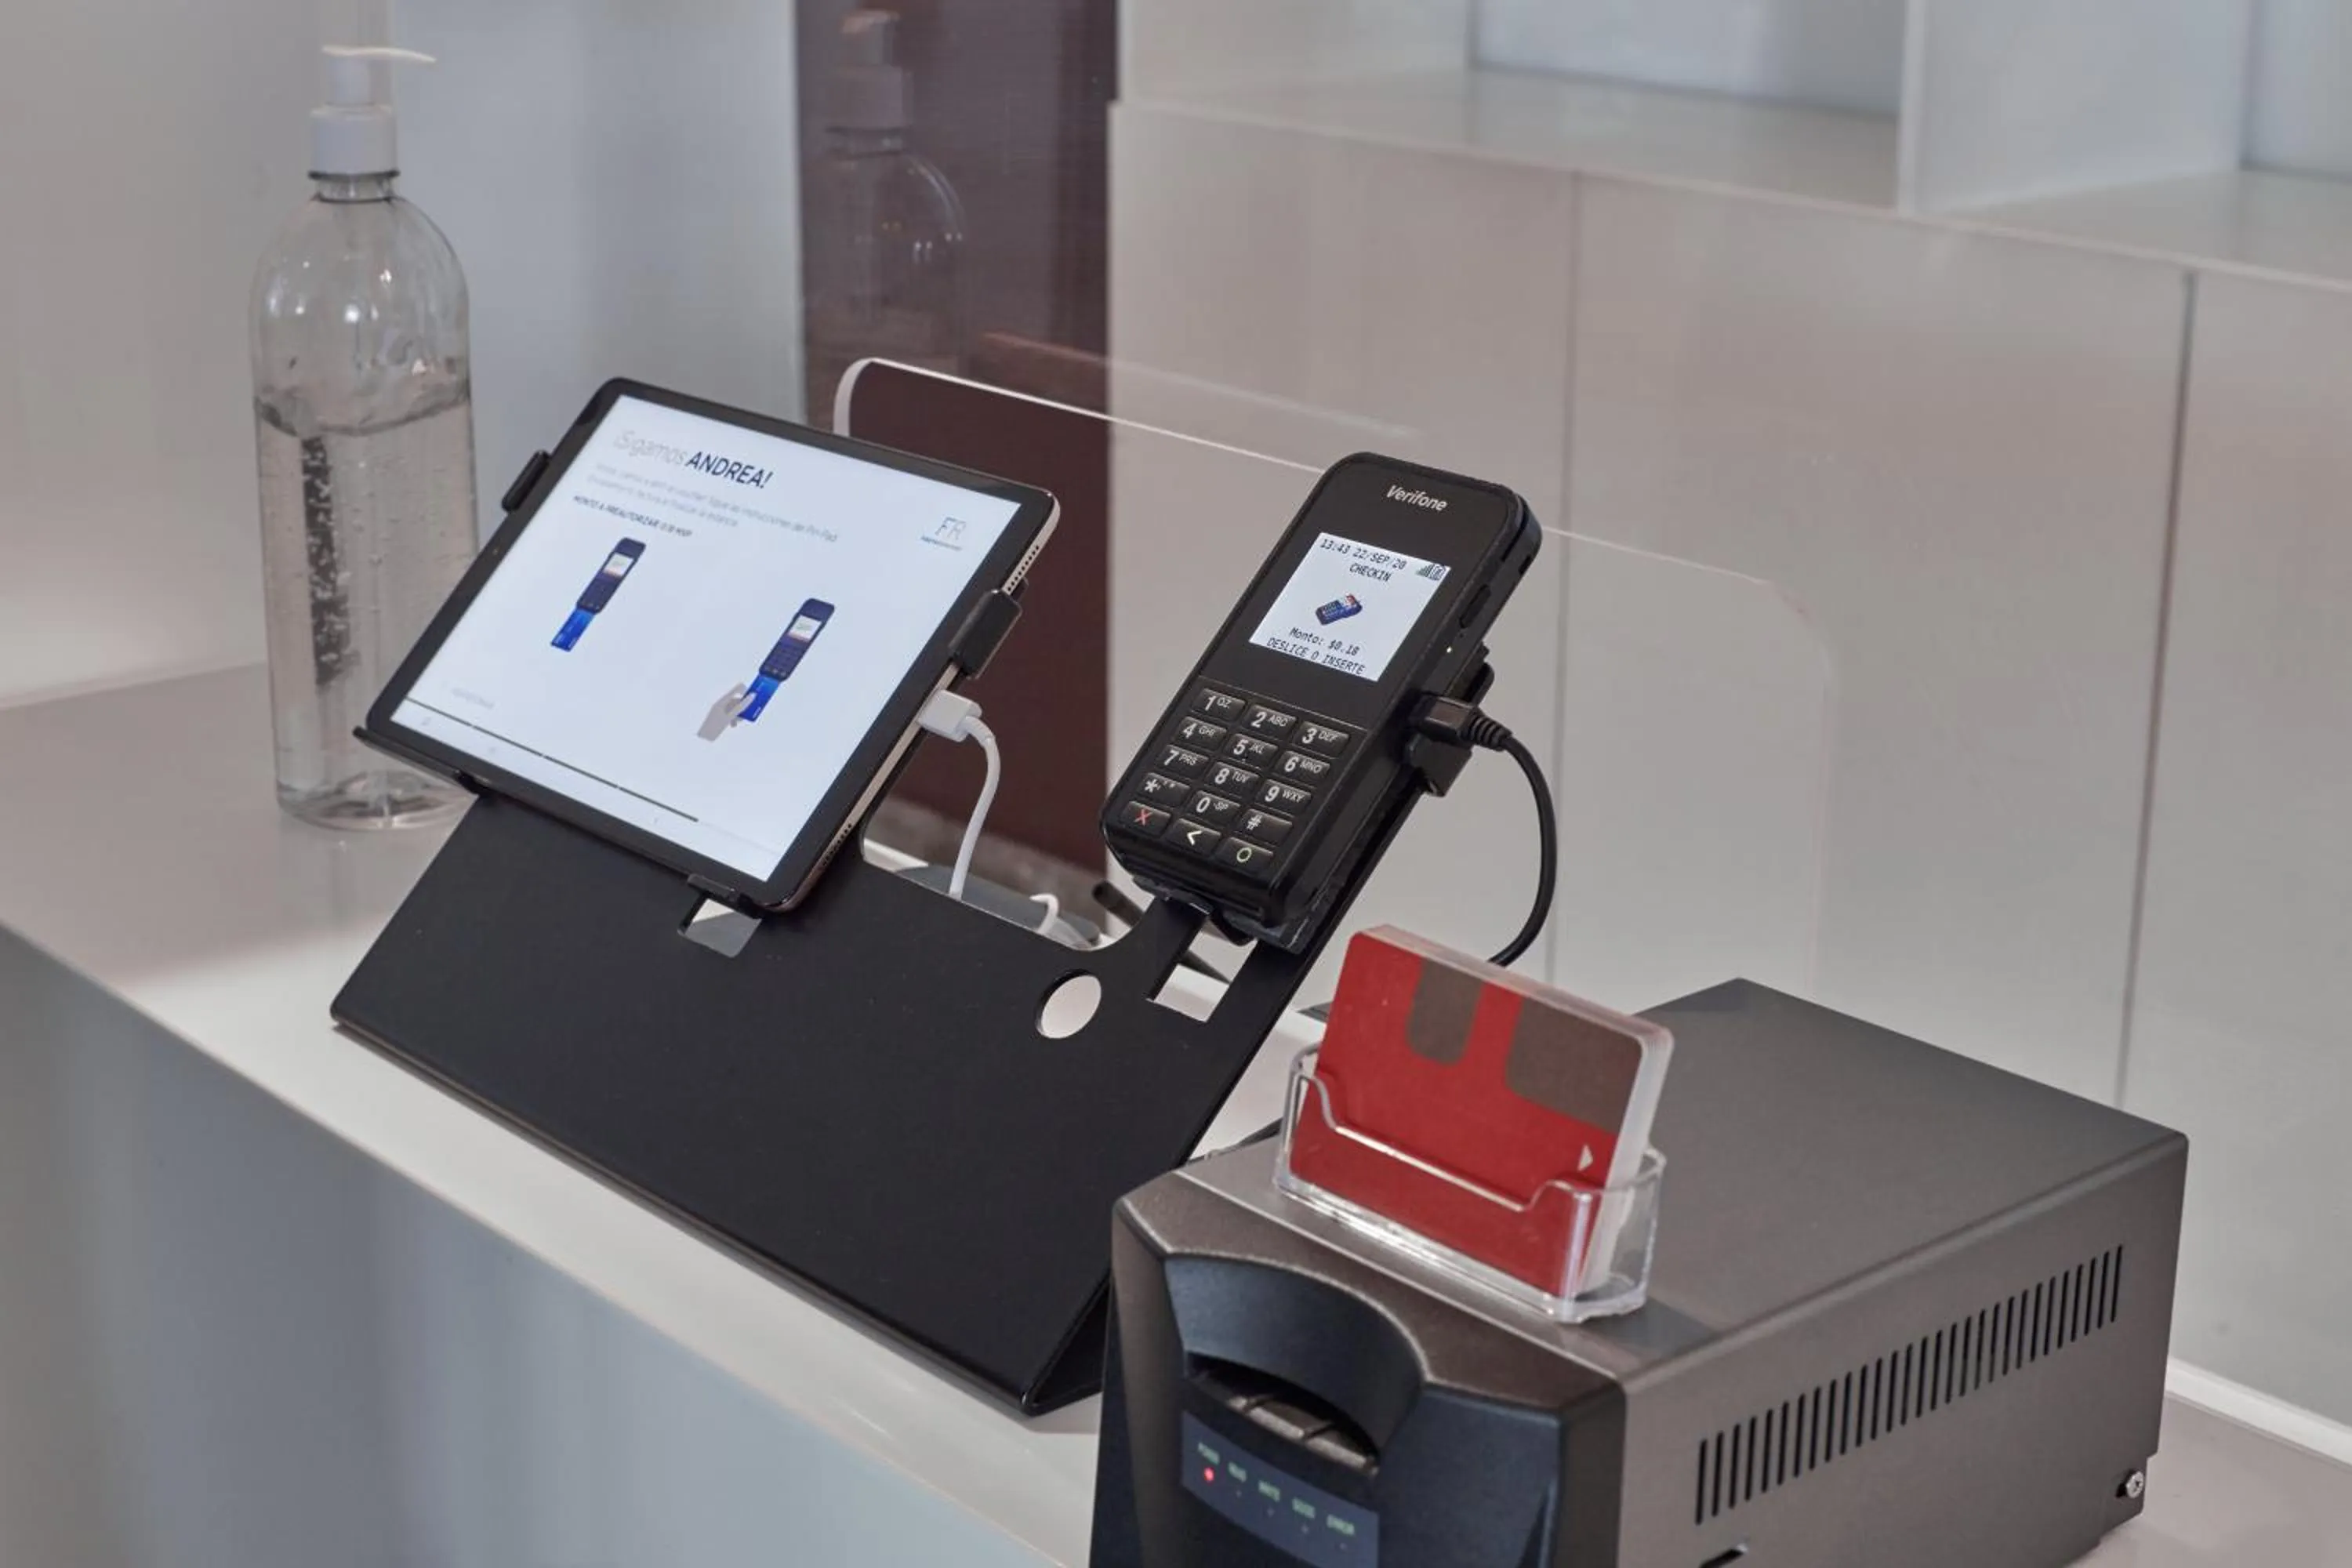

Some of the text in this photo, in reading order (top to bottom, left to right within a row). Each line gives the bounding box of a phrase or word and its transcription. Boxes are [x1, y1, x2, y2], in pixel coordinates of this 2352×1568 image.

[685, 452, 773, 488] ANDREA!
[1386, 485, 1447, 511] Verifone
[1349, 562, 1392, 582] CHECKIN
[1290, 627, 1323, 645] Monto:
[1267, 637, 1309, 659] DESLICE
[1322, 655, 1365, 675] INSERTE
[1204, 695, 1216, 711] 1
[1250, 711, 1267, 728] 2
[1182, 722, 1198, 739] 4
[1301, 727, 1318, 744] 3
[1233, 739, 1249, 755] 5
[1163, 750, 1180, 766] 7
[1284, 756, 1300, 772] 6
[1214, 768, 1230, 785] 8
[1265, 786, 1280, 802] 9
[1196, 797, 1211, 813] 0
